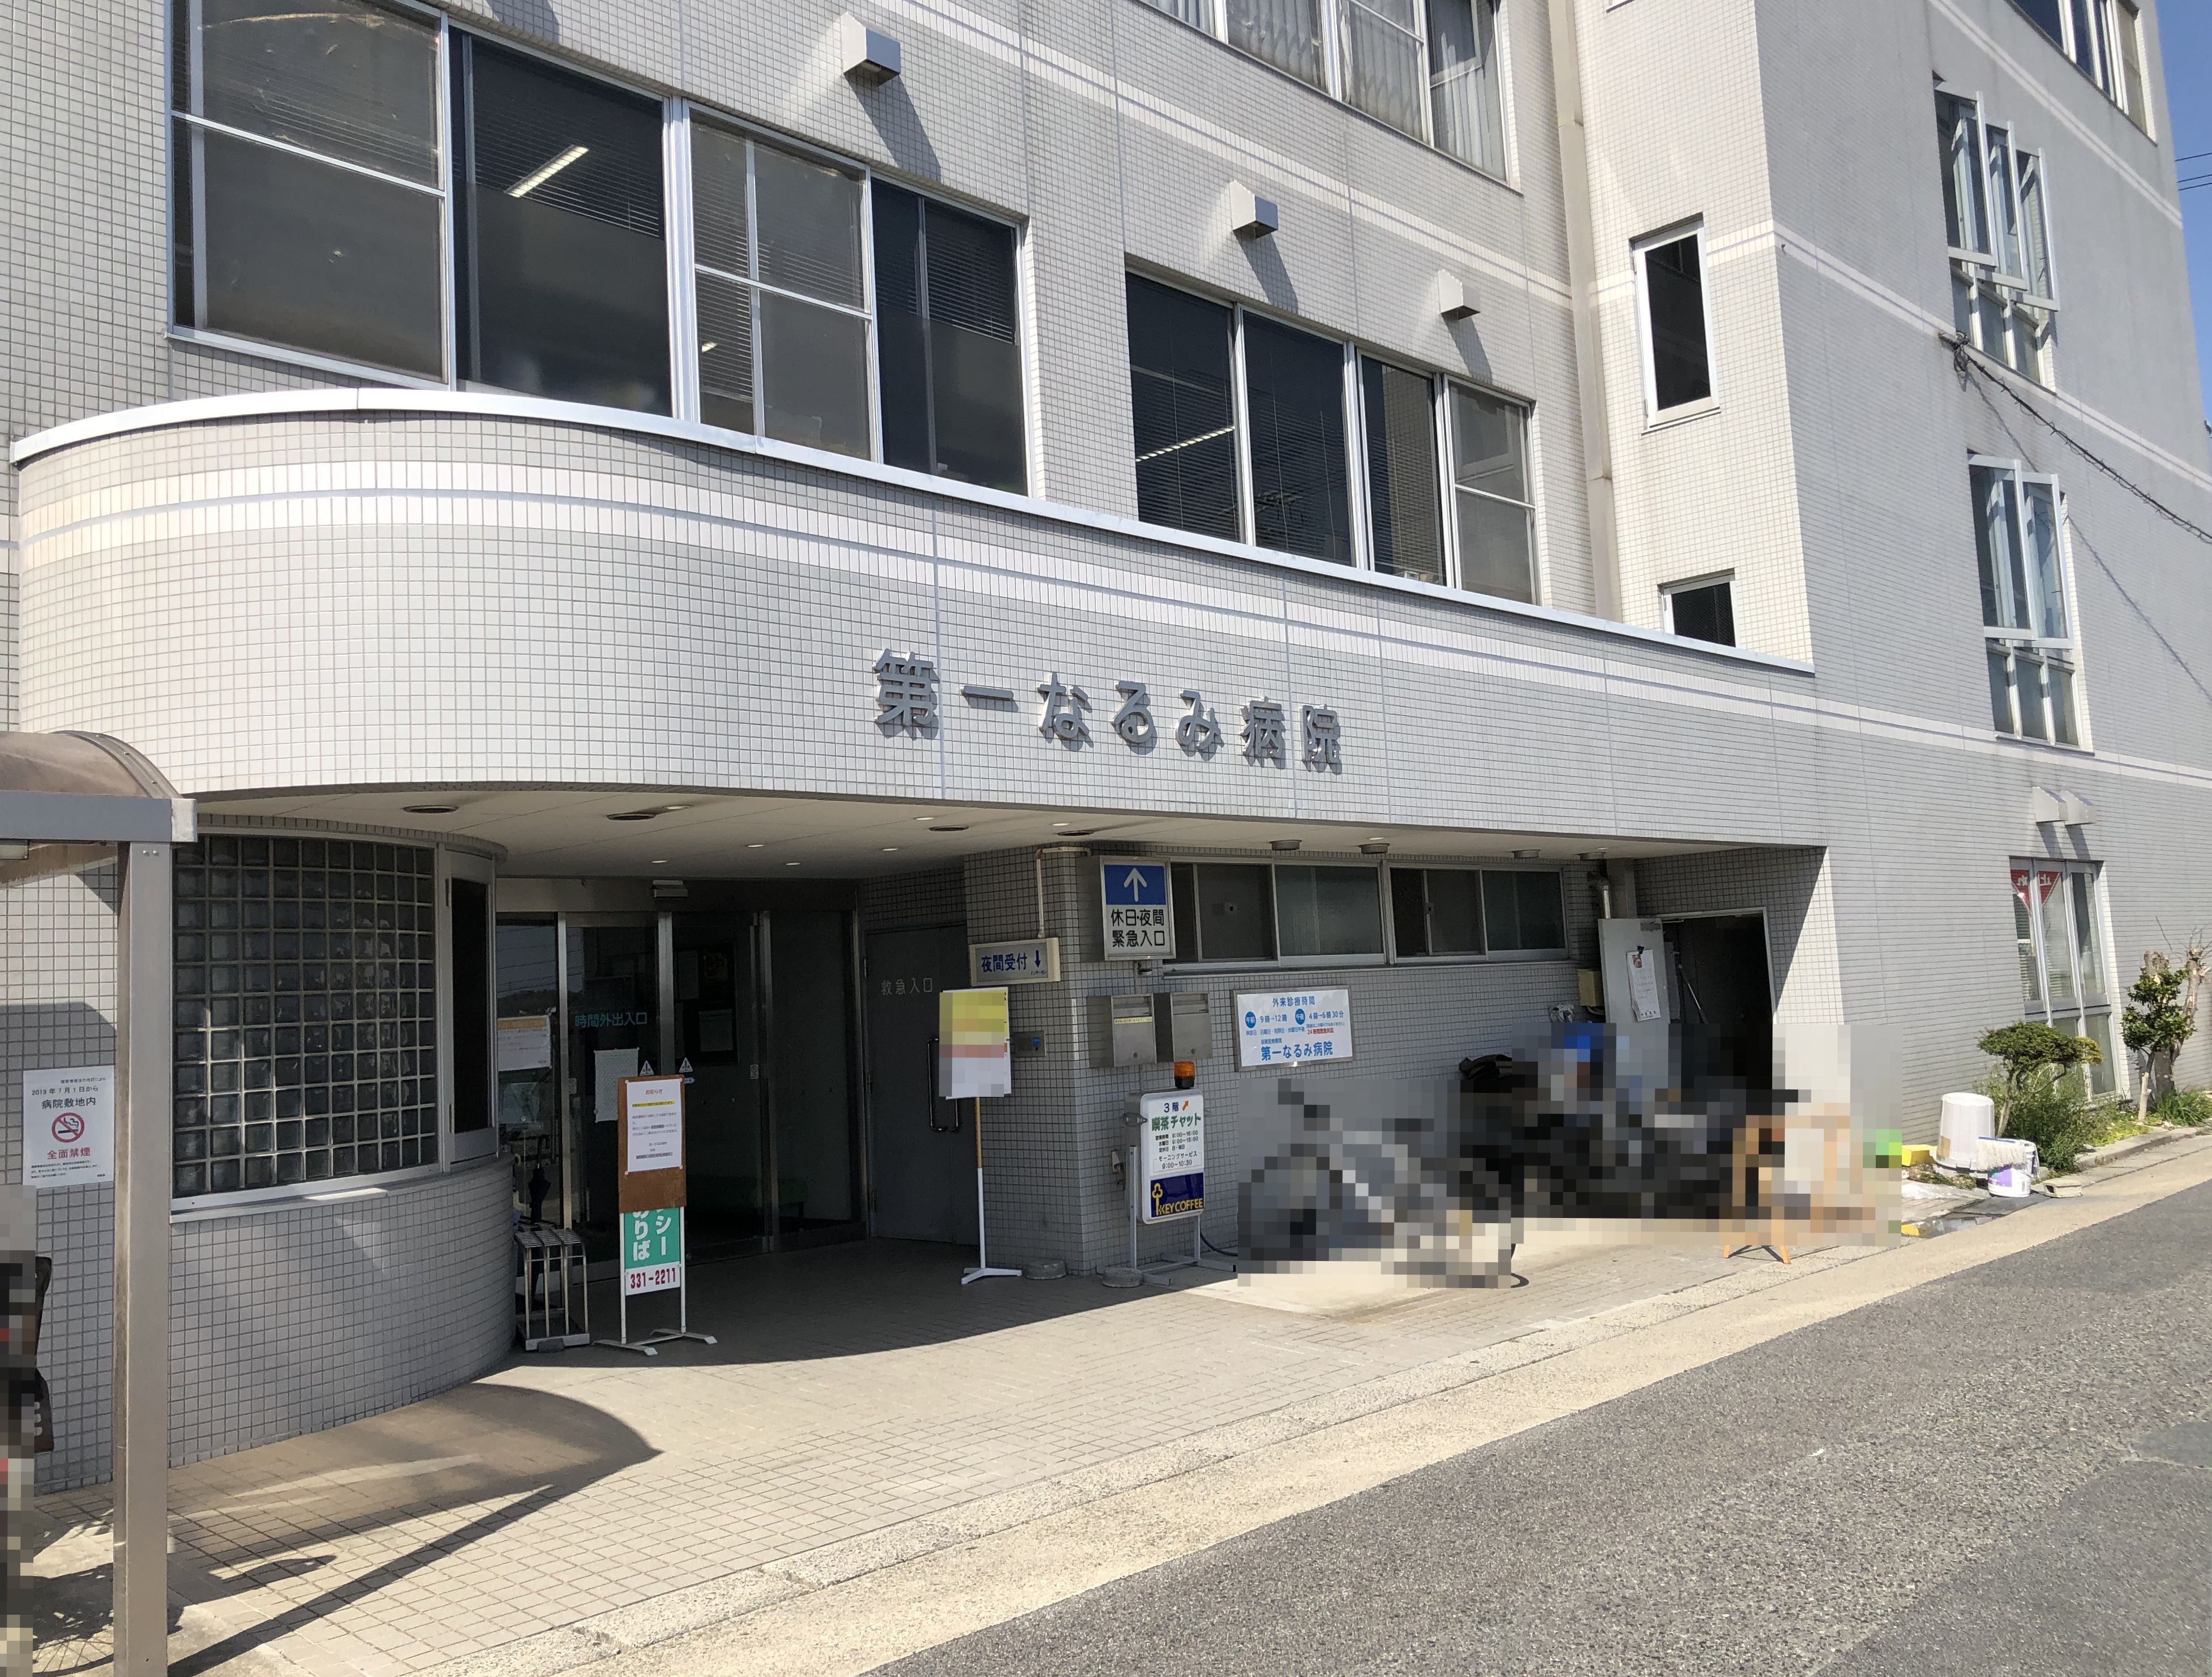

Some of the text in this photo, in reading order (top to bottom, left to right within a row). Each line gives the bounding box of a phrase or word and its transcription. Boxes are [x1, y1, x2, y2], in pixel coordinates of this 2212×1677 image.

[873, 648, 1341, 765] 第一なるみ病院
[1112, 930, 1165, 947] 緊急入口
[981, 953, 1027, 972] 夜間受付
[881, 977, 932, 995] 救急入口
[1272, 996, 1315, 1007] 外来診療時間
[575, 1012, 647, 1027] 時間外出入口
[1261, 1041, 1333, 1061] 第一なるみ病院
[41, 1097, 96, 1109] 病院敷地内
[1164, 1102, 1179, 1113] 3階
[47, 1147, 91, 1160] 全面禁煙
[1159, 1151, 1197, 1161] モーニングサービス
[1158, 1198, 1203, 1215] KEY COFFEE
[631, 1267, 676, 1289] 331-2211
